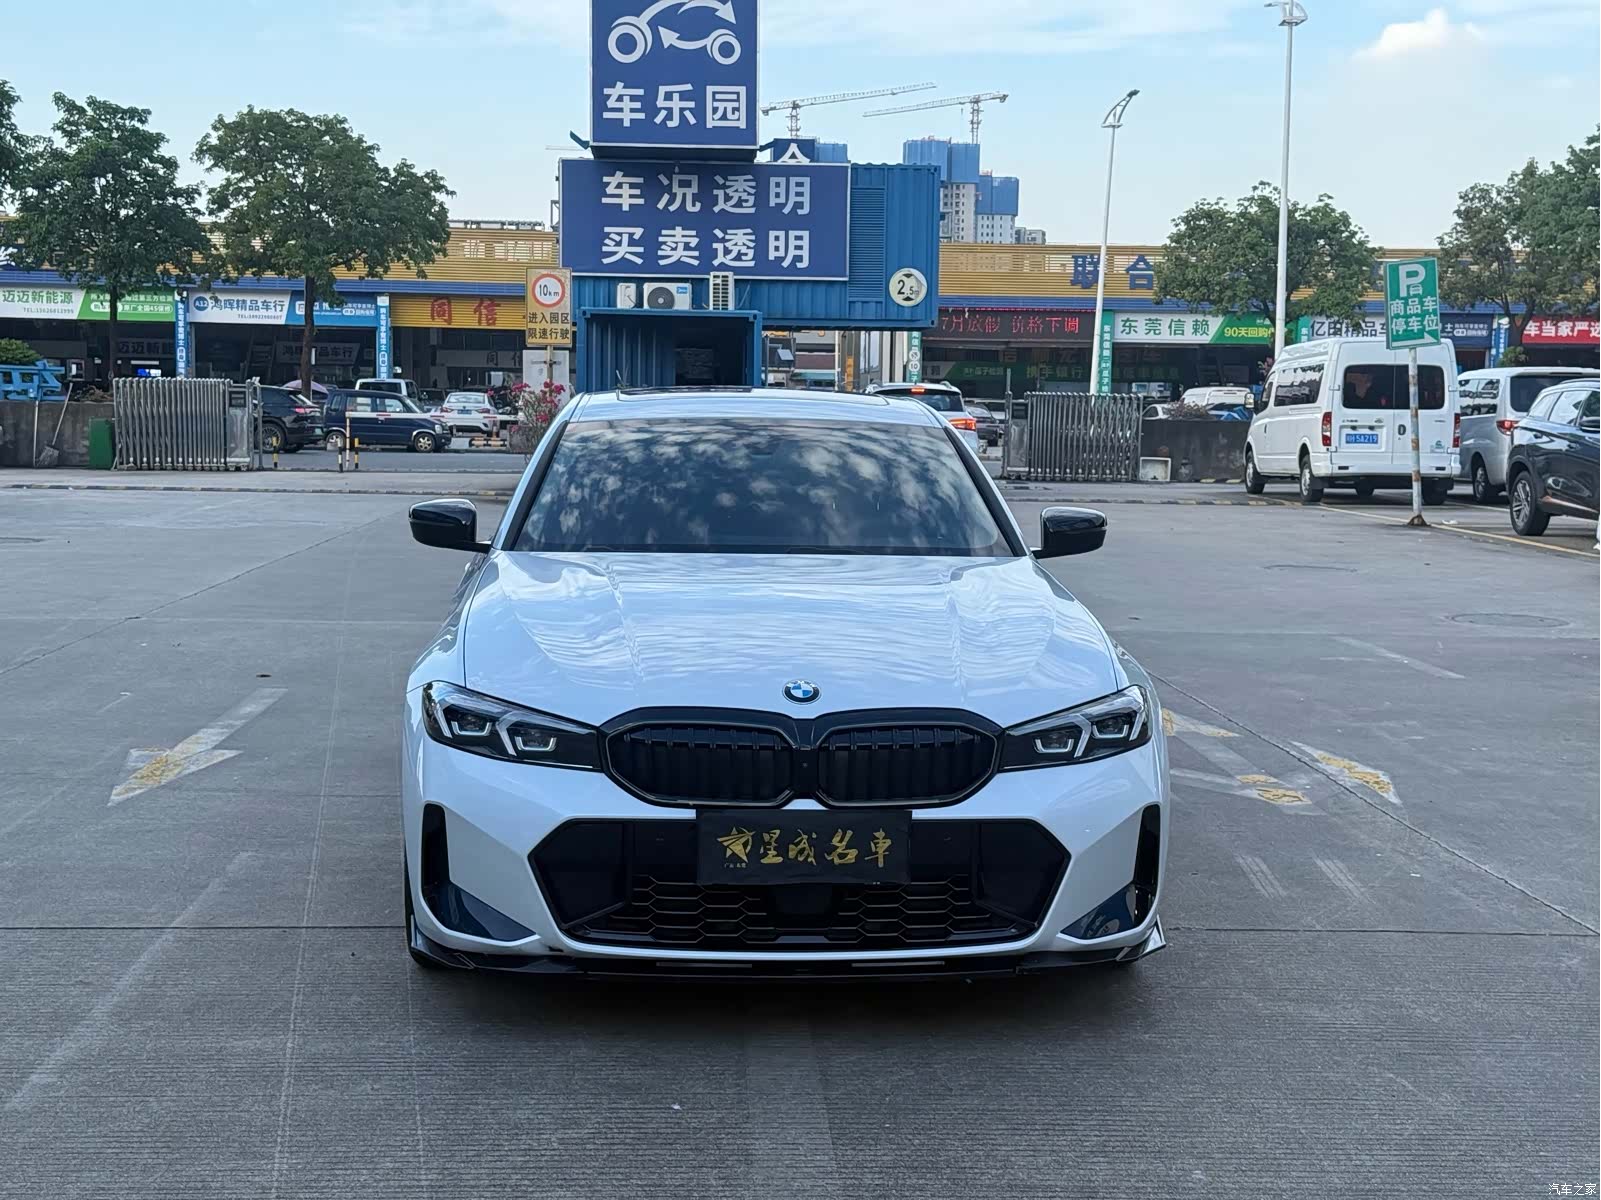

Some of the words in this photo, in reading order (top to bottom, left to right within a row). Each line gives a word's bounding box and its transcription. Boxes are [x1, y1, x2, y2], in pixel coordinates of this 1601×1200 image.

[602, 81, 747, 129] 车乐园
[601, 170, 811, 215] 车况透明
[601, 225, 810, 269] 买卖透明
[1399, 263, 1426, 298] P
[2, 289, 74, 304] 迈迈新能源
[194, 300, 208, 308] A12
[1390, 295, 1438, 317] 商品车
[431, 296, 501, 326] 同信
[528, 312, 570, 324] 进入园区
[527, 327, 570, 340] 限速行驶
[1119, 317, 1210, 337] 东莞信赖
[1391, 314, 1440, 336] 停车位
